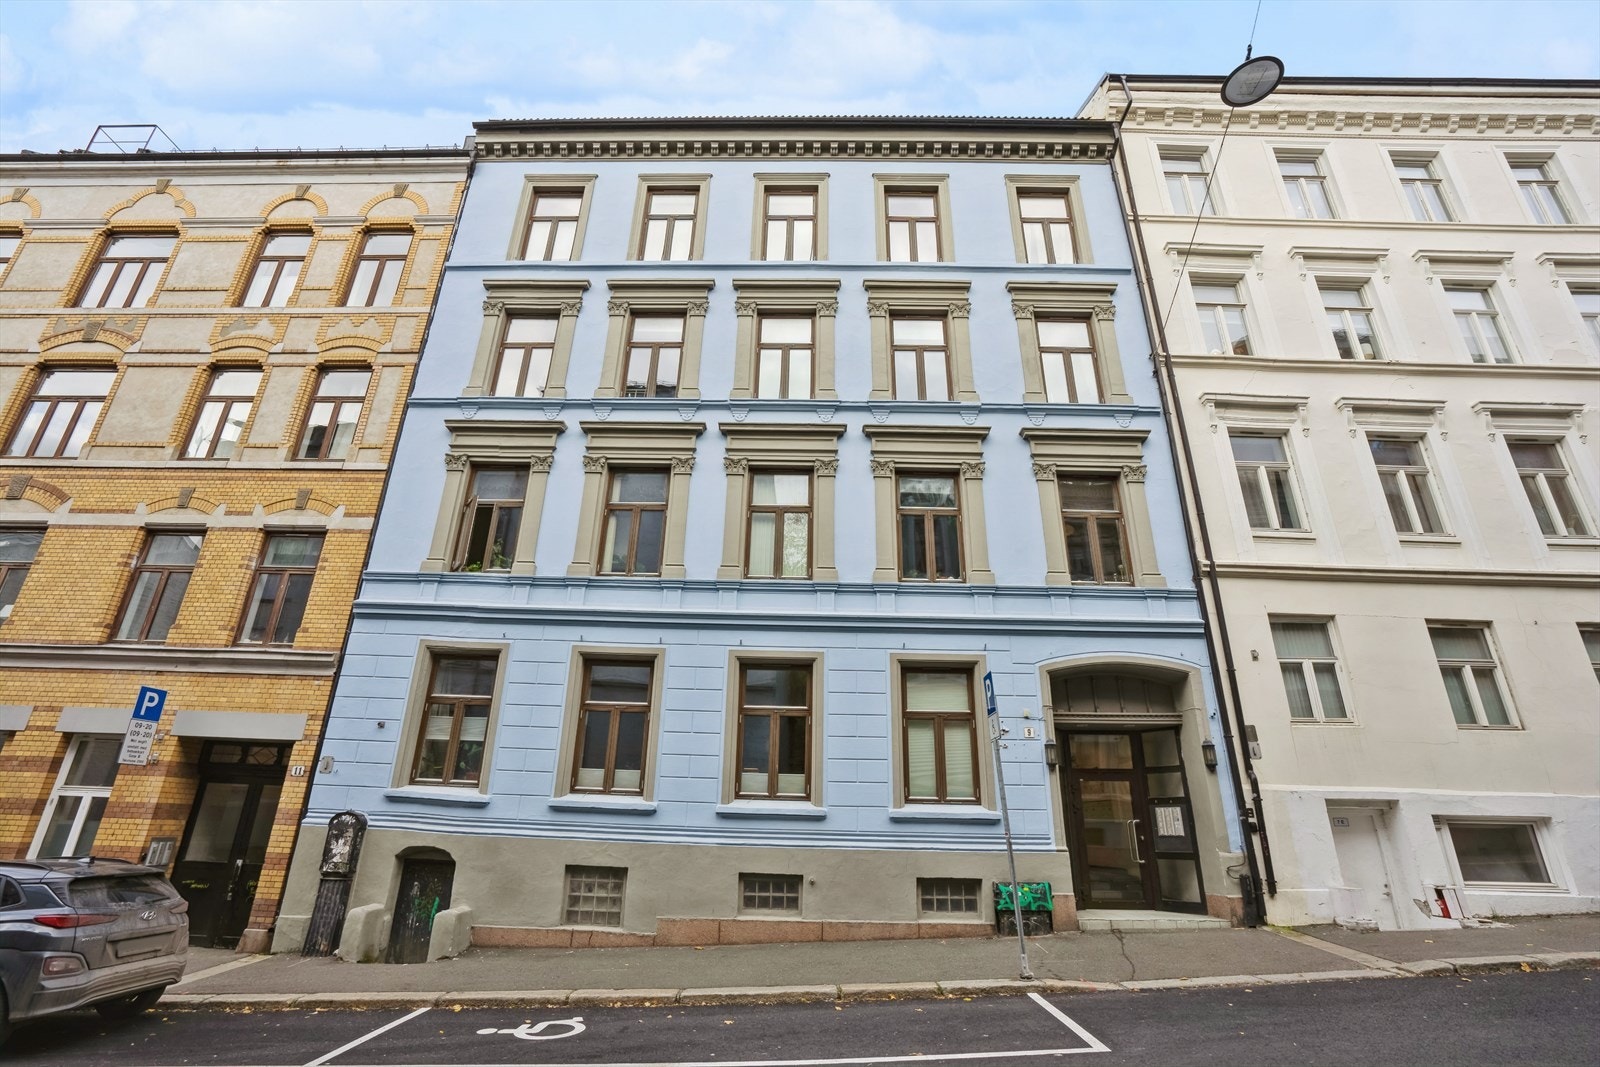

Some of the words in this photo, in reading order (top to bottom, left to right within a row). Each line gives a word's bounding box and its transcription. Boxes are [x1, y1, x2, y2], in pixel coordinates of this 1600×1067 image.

[140, 691, 159, 715] P
[135, 722, 152, 730] 09-20
[1027, 728, 1032, 736] 9
[294, 766, 302, 775] 11
